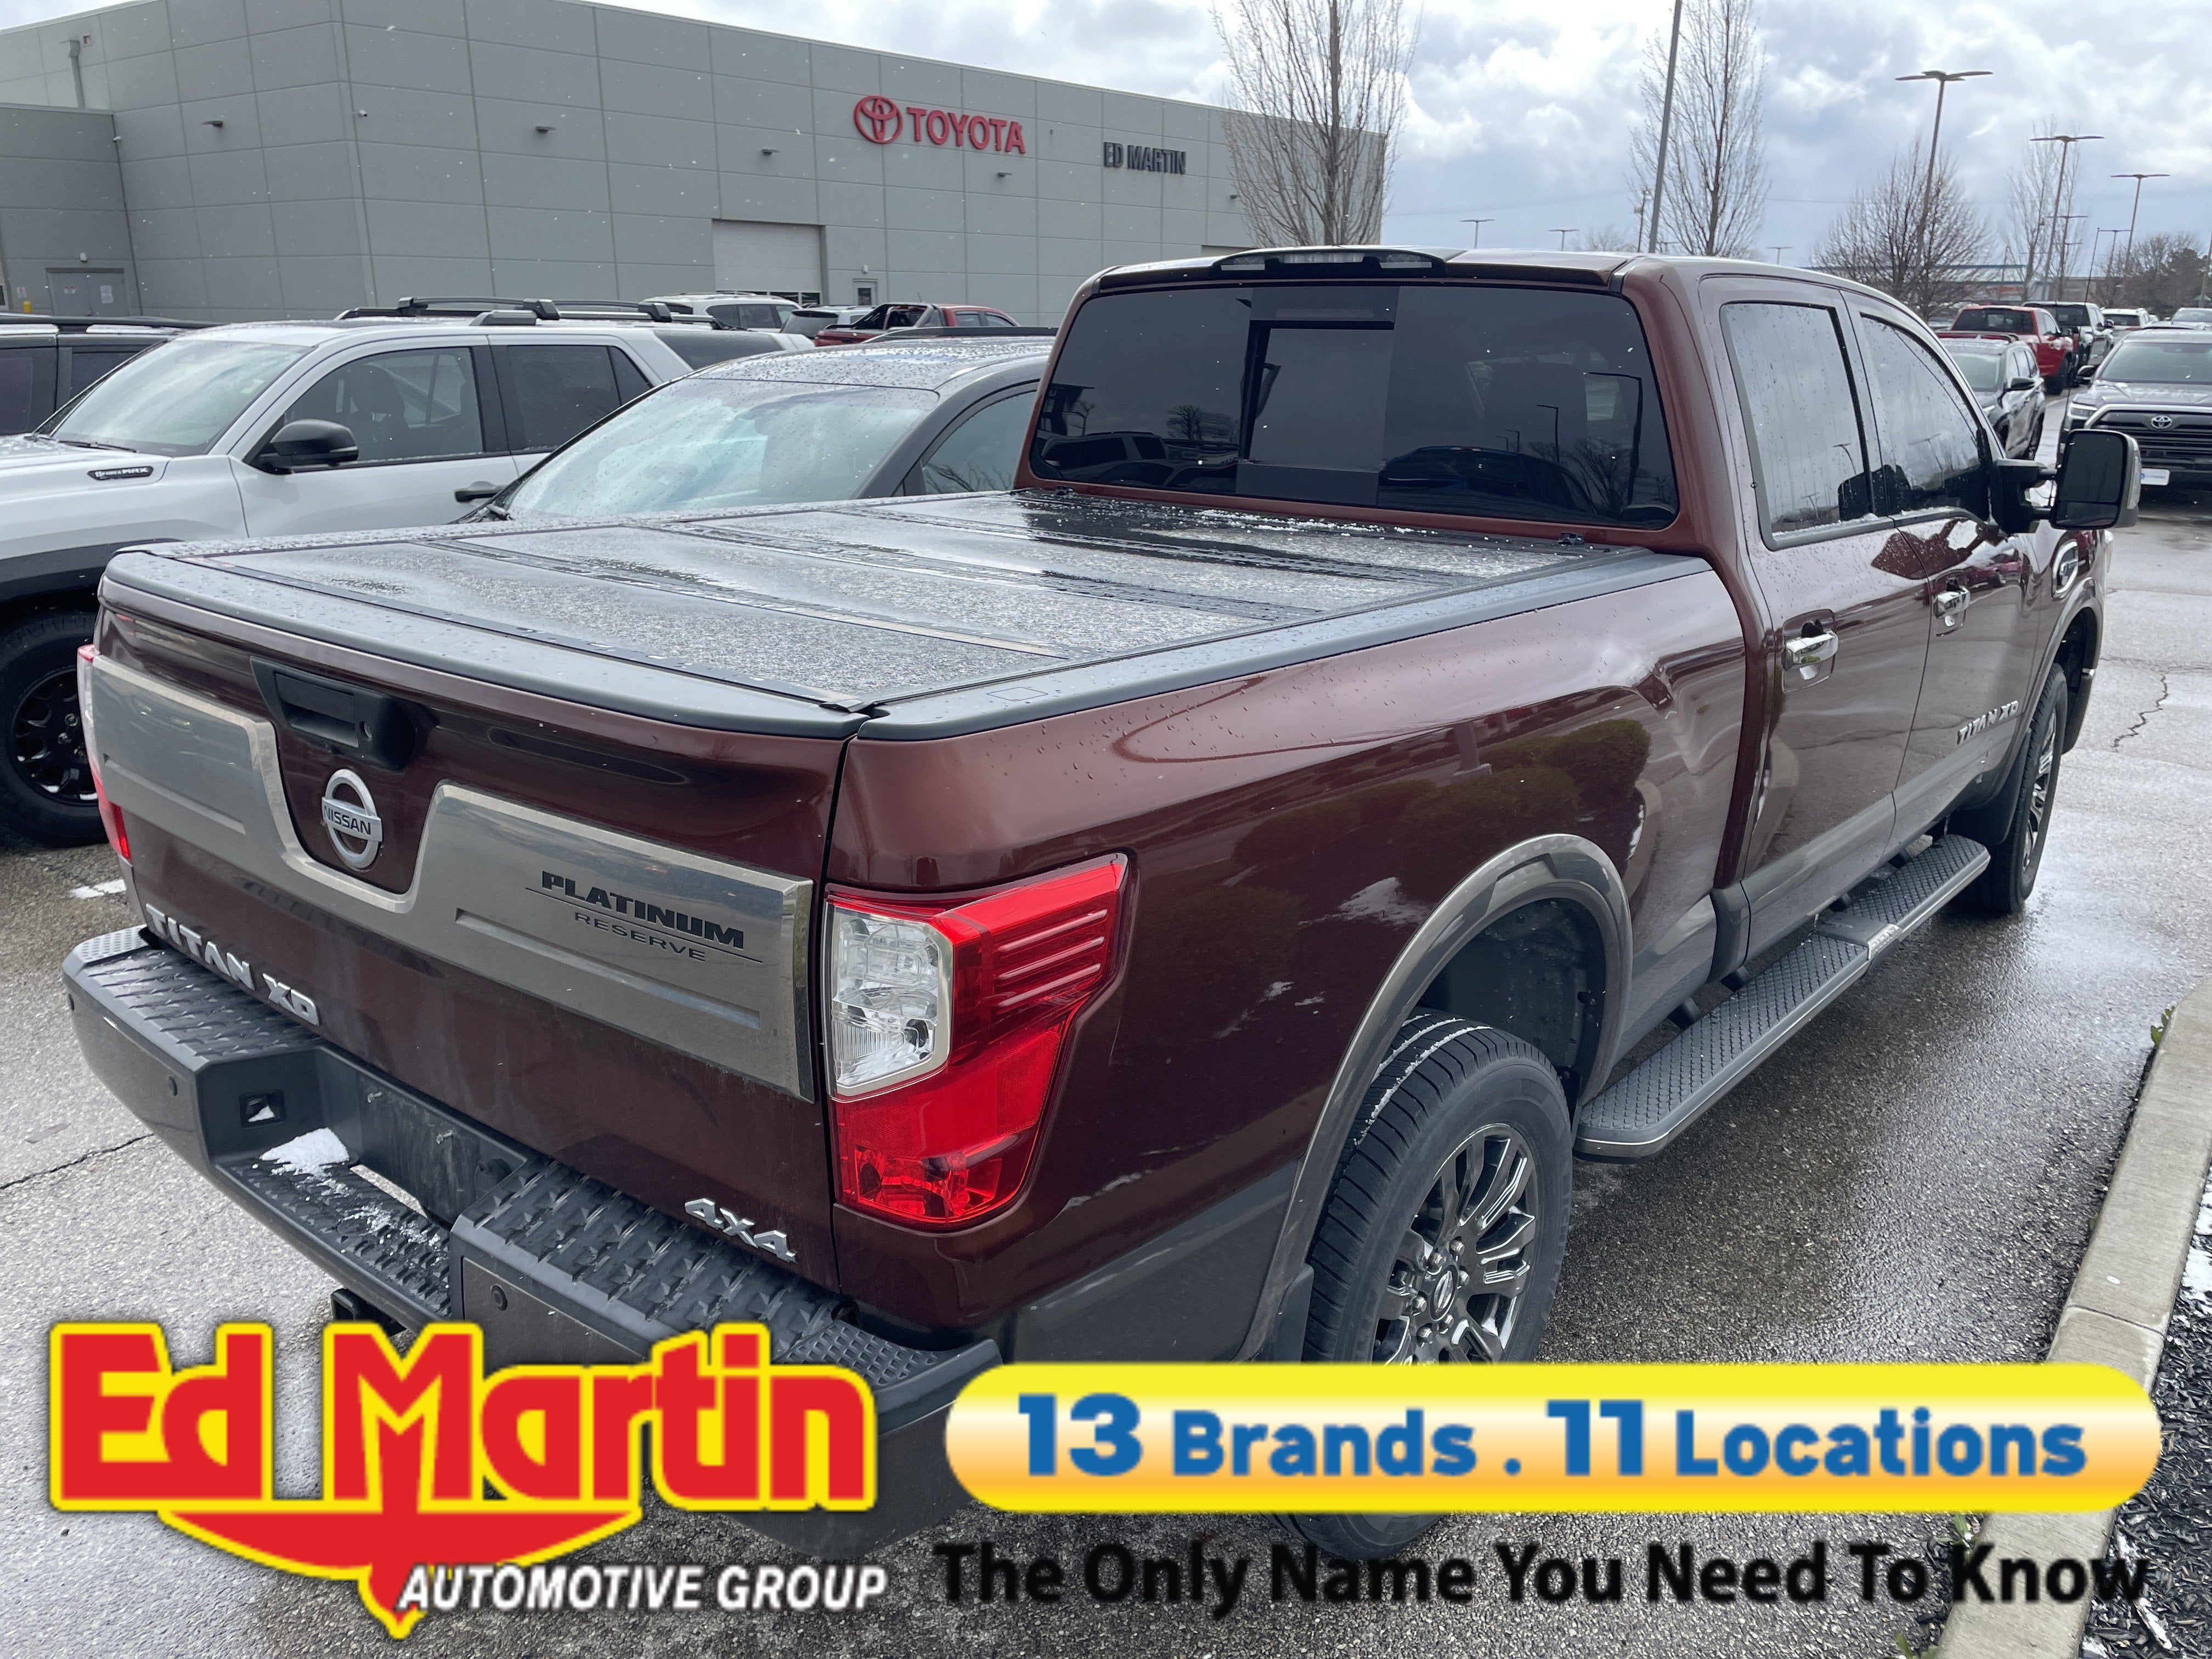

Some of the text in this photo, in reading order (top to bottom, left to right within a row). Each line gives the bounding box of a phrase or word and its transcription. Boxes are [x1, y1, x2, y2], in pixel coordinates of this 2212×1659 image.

[906, 106, 1026, 154] TOYOTA
[1103, 142, 1186, 174] ED MARTIN
[1957, 700, 2019, 744] TITAN XD
[323, 805, 371, 836] NISSAN
[542, 871, 744, 950] PLATINUM
[574, 912, 706, 962] RESERVE
[145, 903, 321, 1026] TITAN XD
